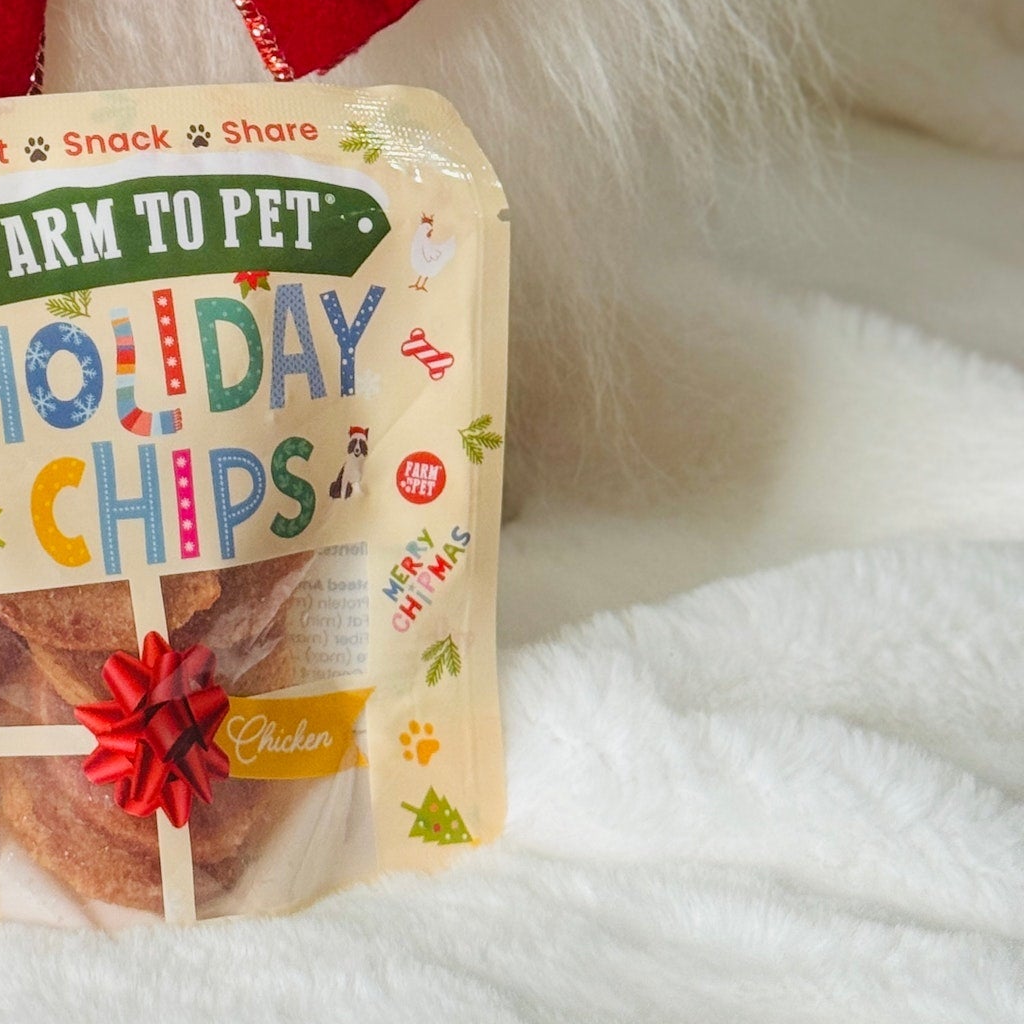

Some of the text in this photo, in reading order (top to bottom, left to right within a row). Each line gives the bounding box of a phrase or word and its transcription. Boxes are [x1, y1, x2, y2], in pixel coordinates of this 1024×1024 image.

[63, 124, 172, 157] Snack
[221, 119, 319, 145] Share
[133, 189, 204, 254] TO
[405, 461, 439, 481] FARM
[411, 478, 436, 496] PET
[29, 436, 318, 575] CHIPS
[382, 527, 434, 603] MERRY
[227, 714, 333, 765] Chicken
